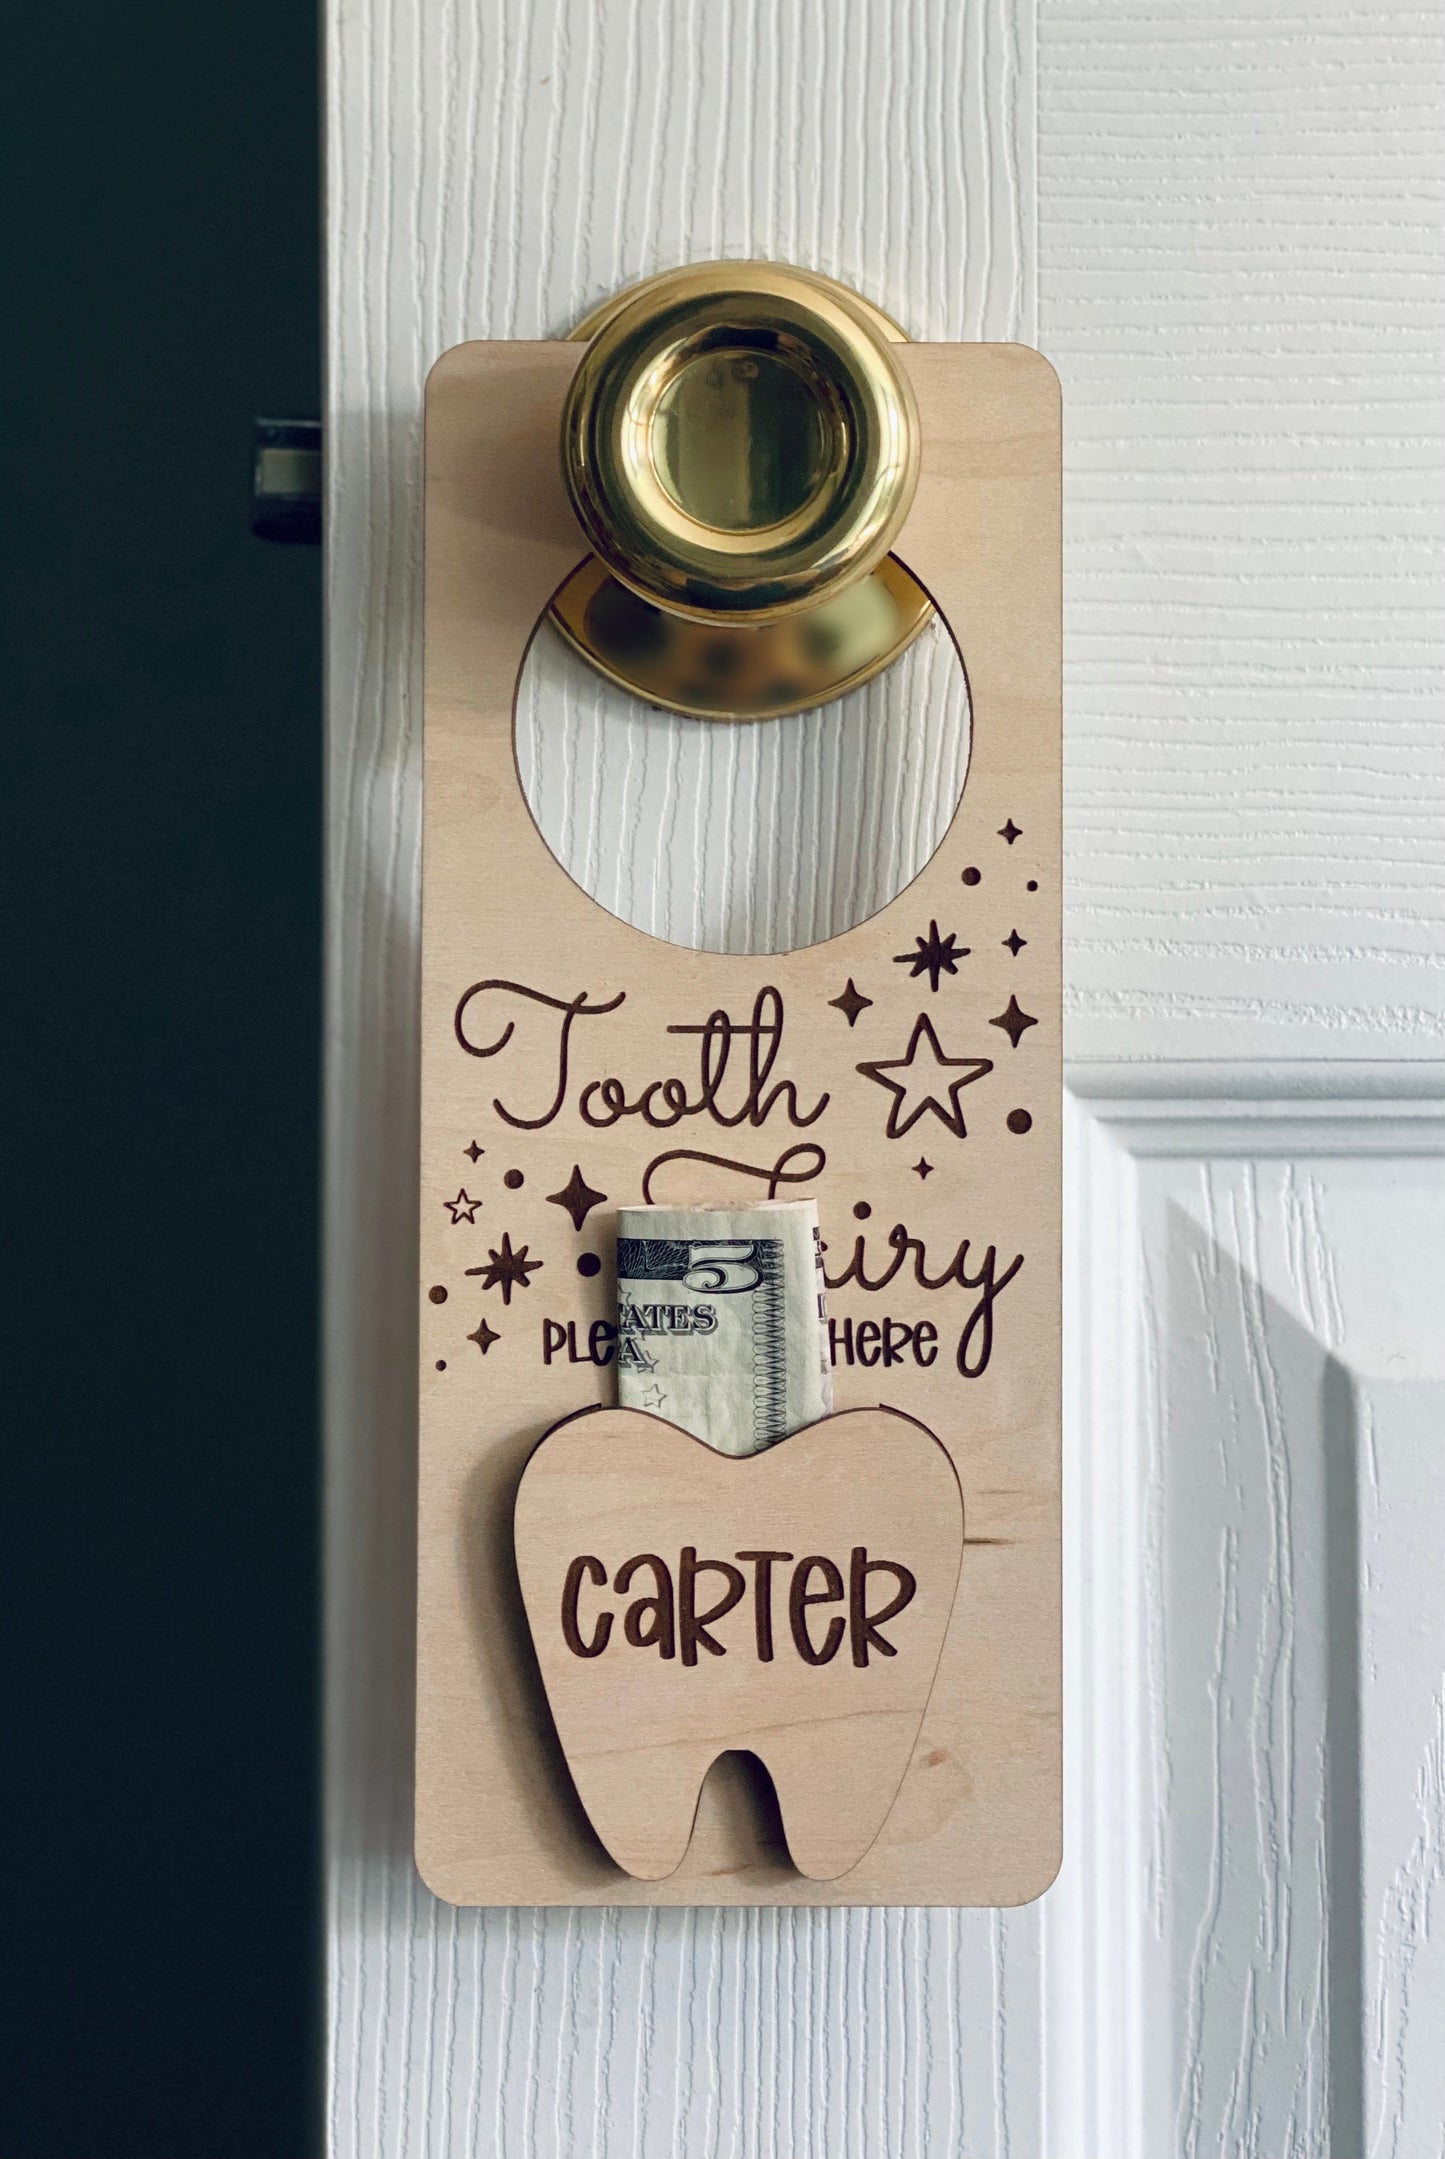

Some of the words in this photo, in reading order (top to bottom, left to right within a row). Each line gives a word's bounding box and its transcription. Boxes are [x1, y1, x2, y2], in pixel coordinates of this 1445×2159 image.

[454, 978, 831, 1130] Tooth
[682, 1242, 764, 1294] 5
[618, 1303, 719, 1337] ATES
